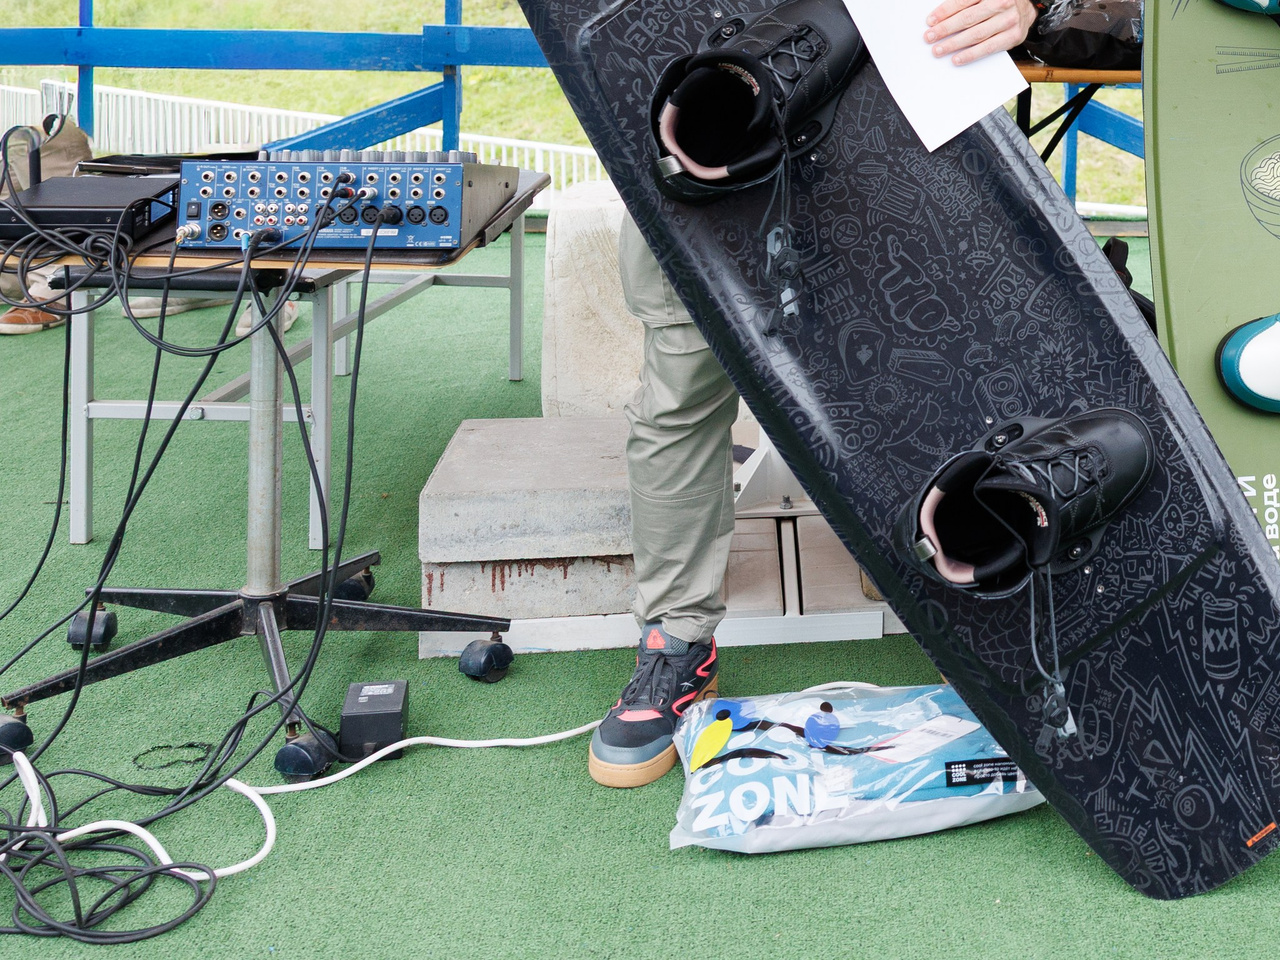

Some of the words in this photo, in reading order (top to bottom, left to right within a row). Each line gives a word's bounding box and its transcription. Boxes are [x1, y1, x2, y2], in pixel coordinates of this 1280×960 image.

[899, 149, 972, 226] WEDNESDAY
[808, 261, 845, 288] PUNK
[923, 261, 944, 280] 150
[821, 297, 861, 326] FEEL
[863, 471, 892, 498] WATER
[1231, 655, 1274, 711] BEST
[1250, 701, 1273, 732] DAY
[1265, 685, 1280, 707] OF
[692, 771, 850, 833] ZONE
[1150, 767, 1180, 810] WAKE
